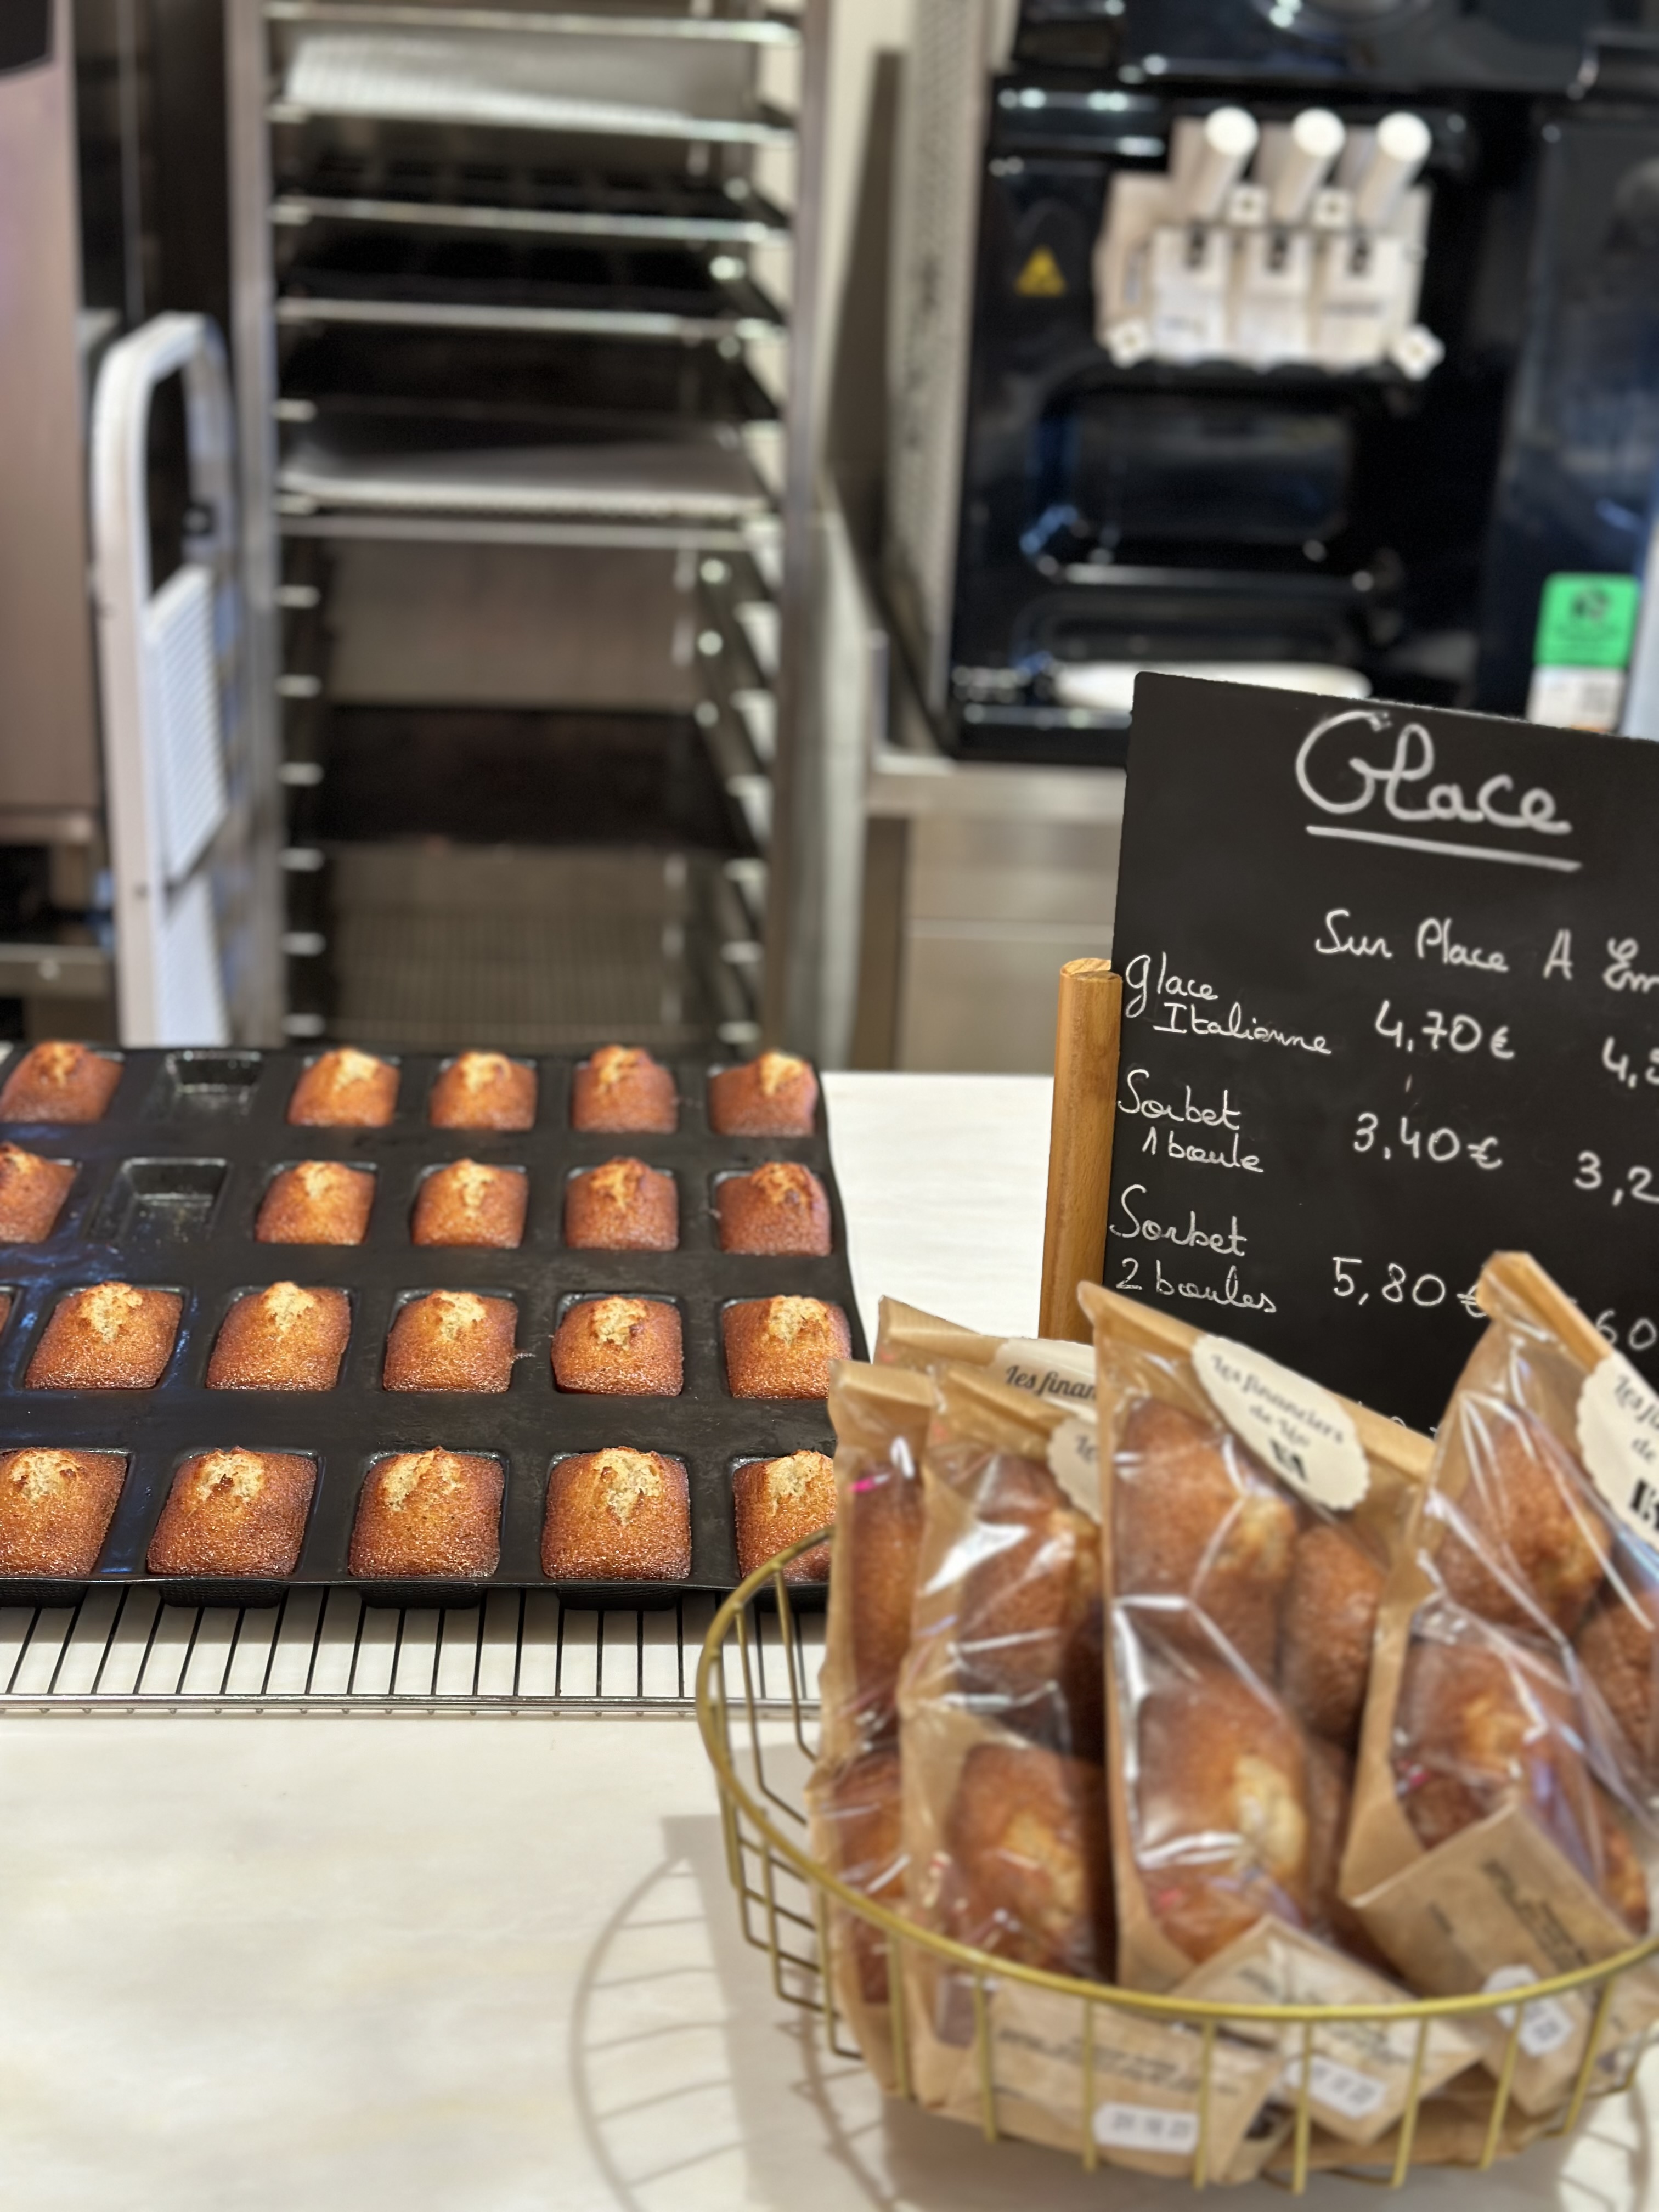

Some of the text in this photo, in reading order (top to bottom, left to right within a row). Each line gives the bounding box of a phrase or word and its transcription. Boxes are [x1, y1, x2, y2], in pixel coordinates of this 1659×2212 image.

[1296, 711, 1572, 834] Glace
[1417, 918, 1509, 972] Place
[1544, 929, 1572, 979] A
[1376, 1000, 1514, 1059] 4,70€
[1118, 1069, 1241, 1130] Sorbet
[1142, 1126, 1264, 1172] 1 boule
[1354, 1113, 1502, 1169] 3,40€
[1109, 1184, 1248, 1256] Sorbet
[1115, 1257, 1277, 1313] 2 boules
